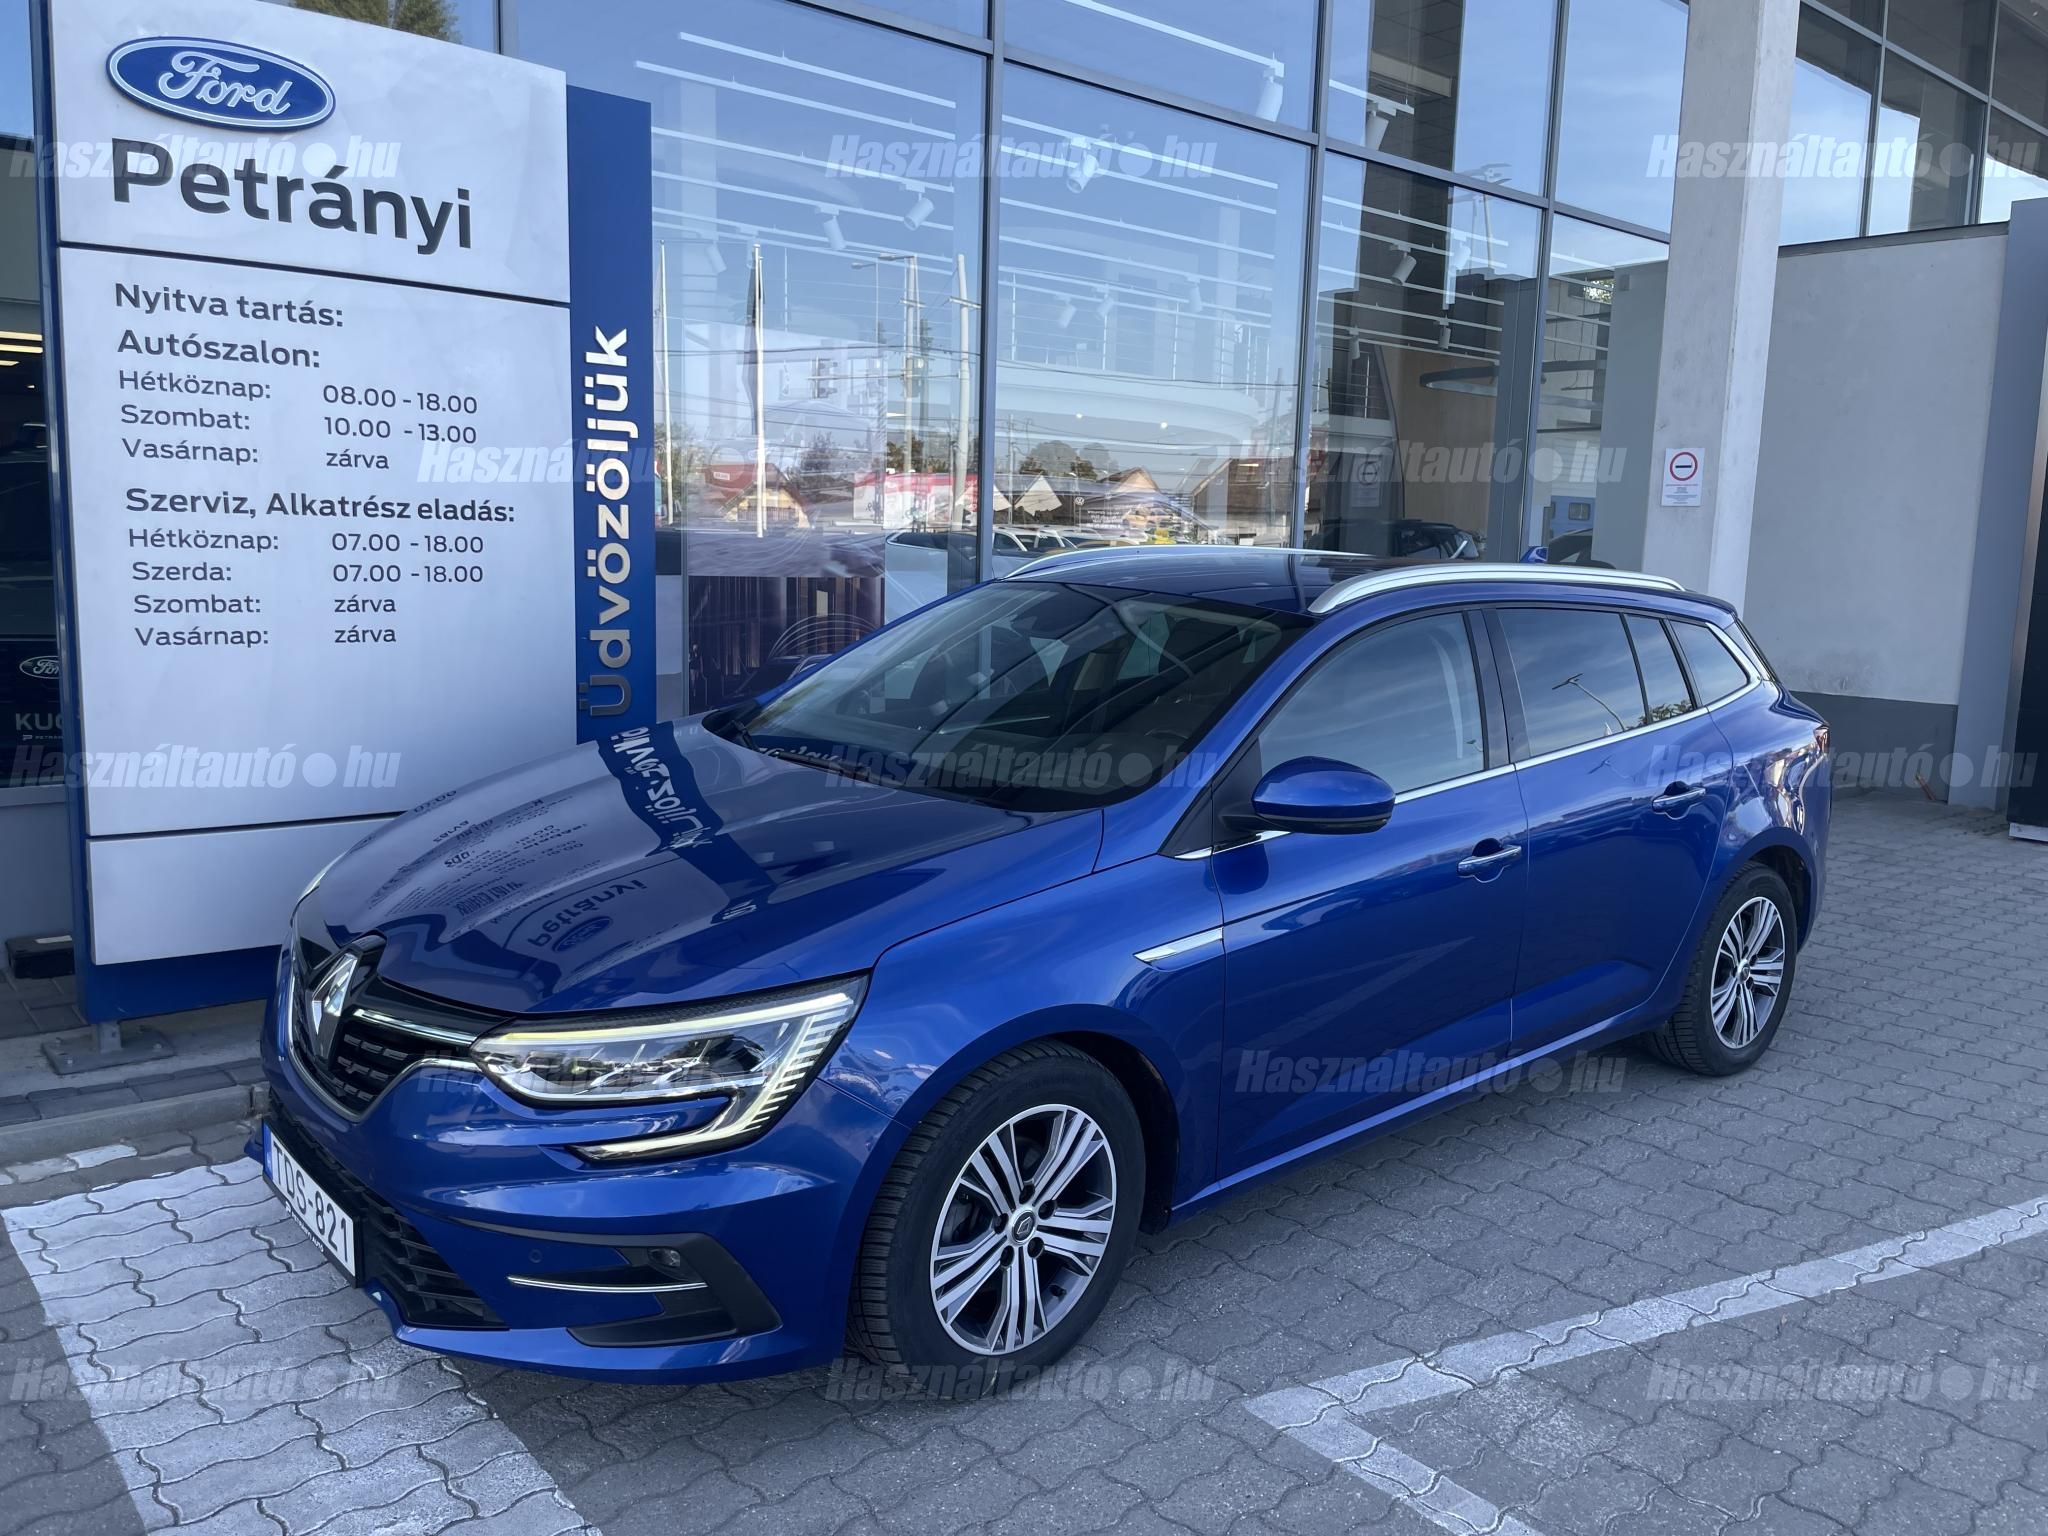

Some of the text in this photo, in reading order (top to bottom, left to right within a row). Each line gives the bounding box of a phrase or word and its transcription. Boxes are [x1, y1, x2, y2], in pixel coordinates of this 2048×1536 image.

[157, 51, 292, 115] Ford
[111, 137, 472, 255] Petrányi
[115, 283, 344, 327] Nyitva tartás:
[117, 329, 320, 368] Autószalon:
[119, 369, 271, 401] Hétköznap:
[323, 384, 396, 408] 08.00
[121, 404, 251, 430] Szombat:
[324, 416, 391, 439] 10.00
[122, 438, 389, 470] Vasárnap: zárva
[126, 488, 515, 522] Szerviz, Alkatrész eladás:
[578, 326, 639, 717] Üdvözöljük
[128, 528, 279, 552] Hétköznap:
[332, 532, 400, 552] 07.00
[132, 562, 232, 581] Szerda:
[333, 564, 401, 582] 07.00
[134, 593, 396, 614] Szombat: zárva
[135, 624, 396, 648] Vasárnap: zárva
[33, 659, 60, 674] For
[273, 1141, 349, 1263] TDS-821
